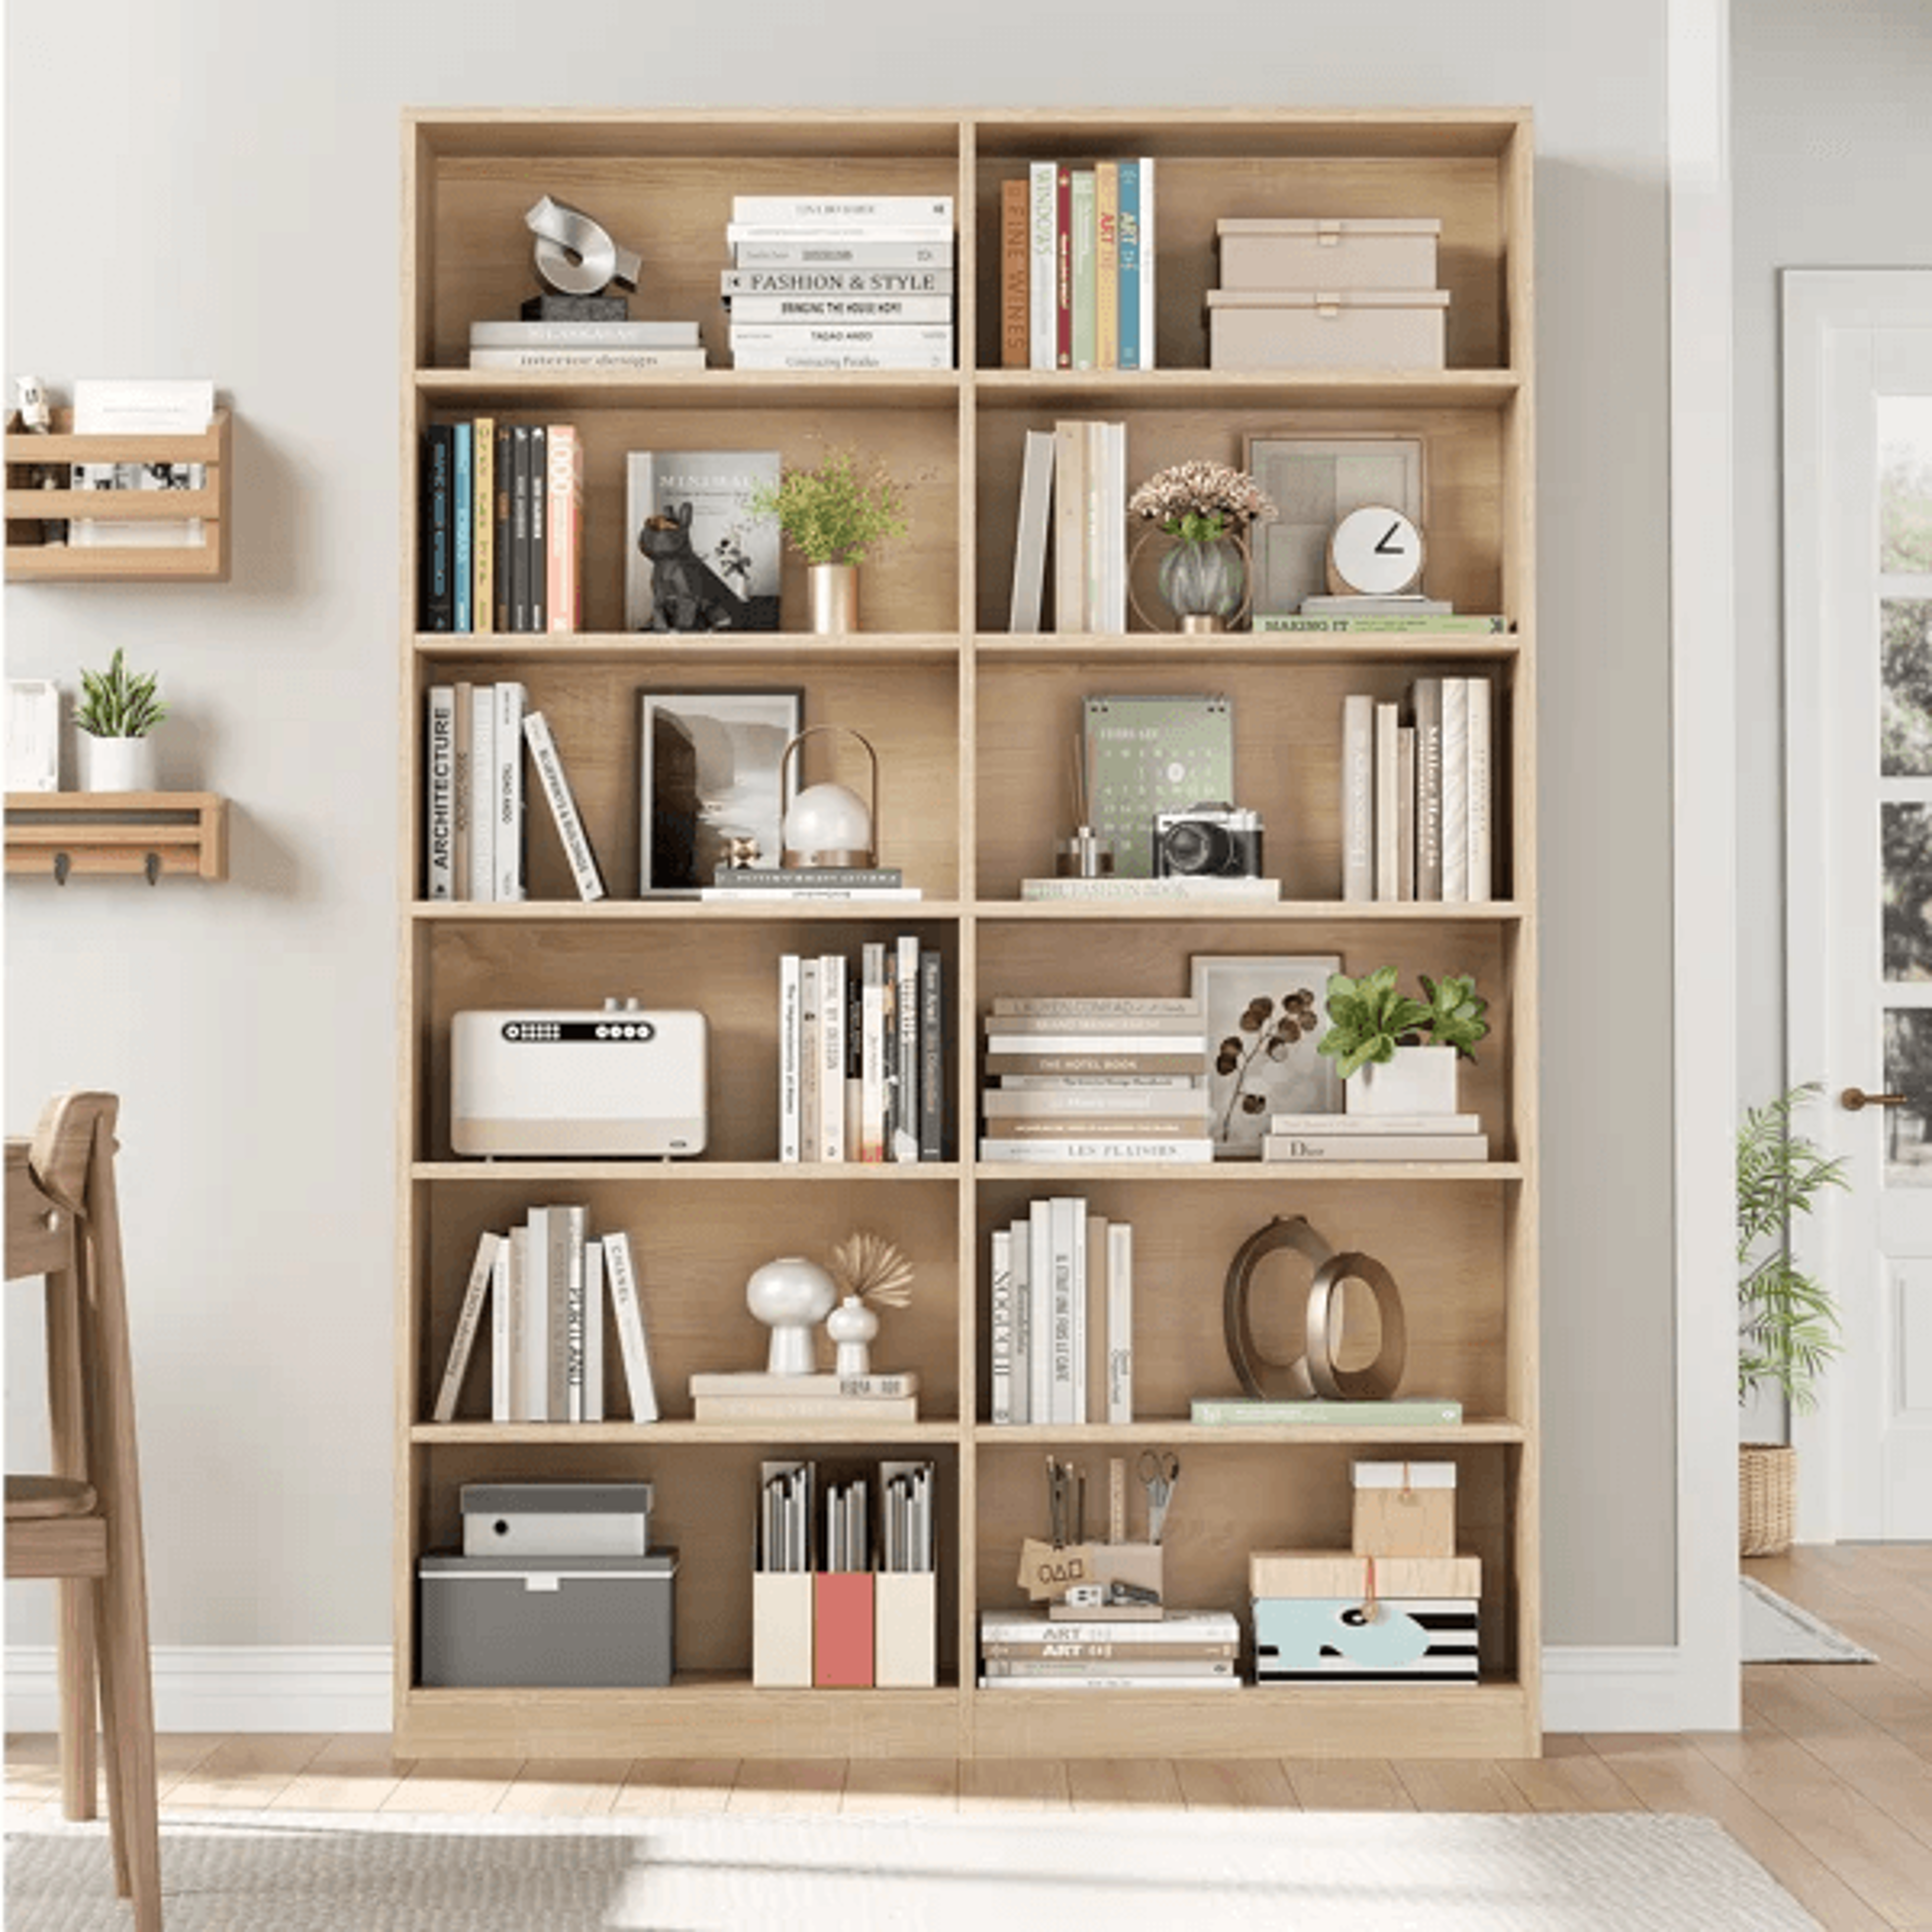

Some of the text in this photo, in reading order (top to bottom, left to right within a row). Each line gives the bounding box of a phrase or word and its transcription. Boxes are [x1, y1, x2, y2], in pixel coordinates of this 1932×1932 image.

[1035, 171, 1053, 255] WINDOWS
[1100, 213, 1115, 245] ART
[1120, 213, 1137, 245] ART
[750, 273, 935, 291] FASHION & STYLE
[1007, 206, 1025, 349] FINE WINES
[1264, 621, 1330, 632] MAKING
[1332, 621, 1349, 632] IT
[434, 707, 451, 869] ARCHITECTURE
[1068, 1146, 1096, 1156] LES
[611, 1246, 629, 1303] CHANEL
[1042, 1627, 1081, 1640] ART
[1042, 1644, 1083, 1657] ART
